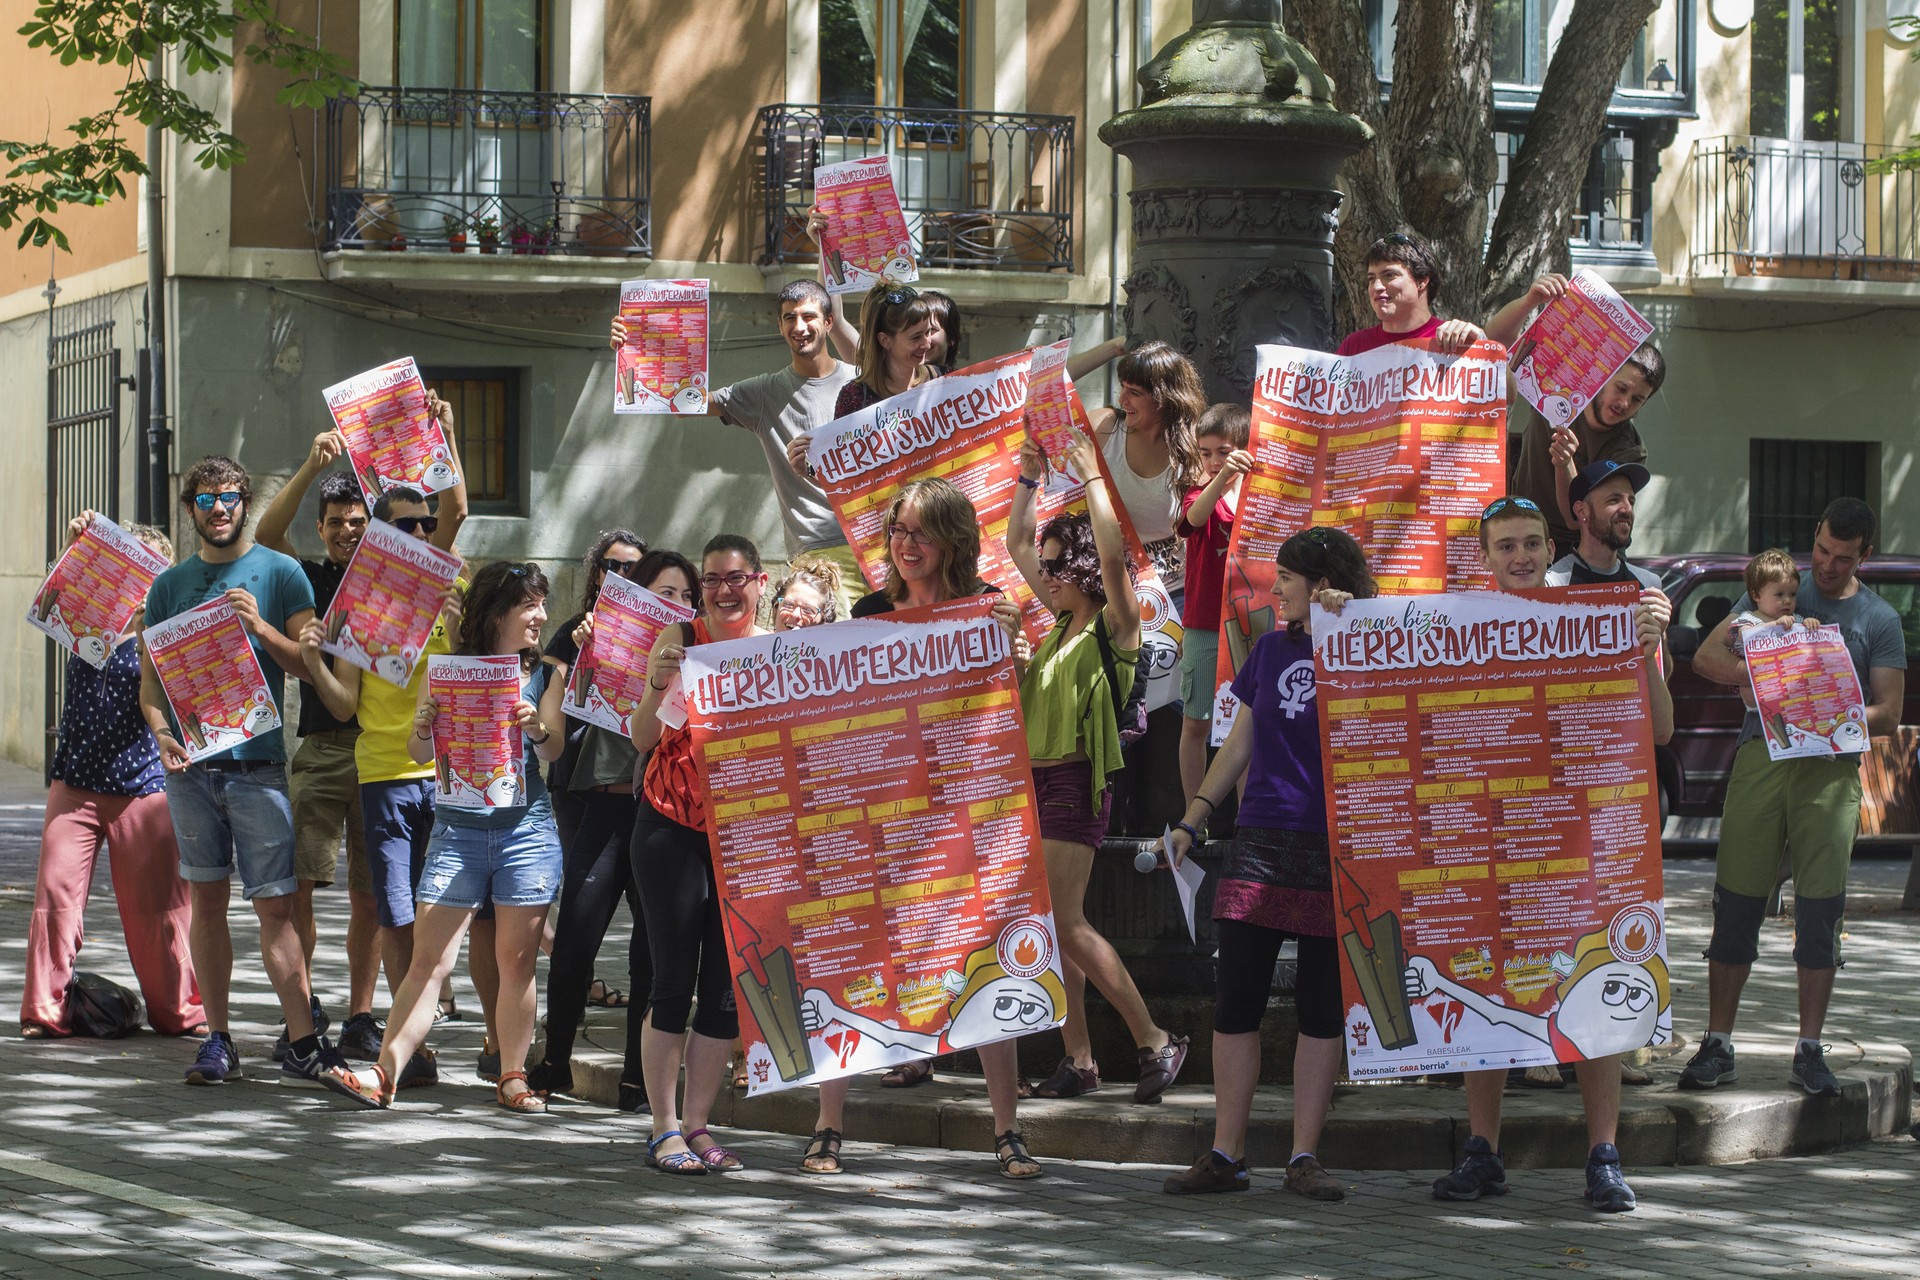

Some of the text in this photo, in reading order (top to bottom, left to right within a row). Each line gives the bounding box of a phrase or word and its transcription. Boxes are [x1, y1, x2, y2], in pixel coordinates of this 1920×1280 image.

[1287, 360, 1365, 389] eman bizia
[897, 369, 1033, 450] SANFERMIN
[836, 406, 914, 444] eman bizia
[1349, 599, 1452, 635] eman bizia
[719, 636, 820, 675] eman bizia
[1587, 682, 1595, 694] 8
[1473, 691, 1479, 702] 7
[960, 698, 970, 710] 8
[1363, 698, 1370, 710] 6
[845, 718, 852, 730] 7
[738, 738, 746, 749] 6
[1367, 762, 1375, 773] 9
[1444, 782, 1456, 795] 10
[1514, 777, 1524, 790] 11
[1612, 786, 1625, 799] 12
[748, 800, 756, 811] 9
[892, 801, 903, 813] 11
[992, 799, 1005, 812] 12
[823, 812, 836, 825] 10
[1536, 861, 1548, 874] 14
[1437, 868, 1450, 881] 13
[921, 881, 934, 894] 14
[825, 898, 837, 912] 13
[1427, 1046, 1472, 1056] BABESLEAK
[1399, 1065, 1419, 1073] GARA
